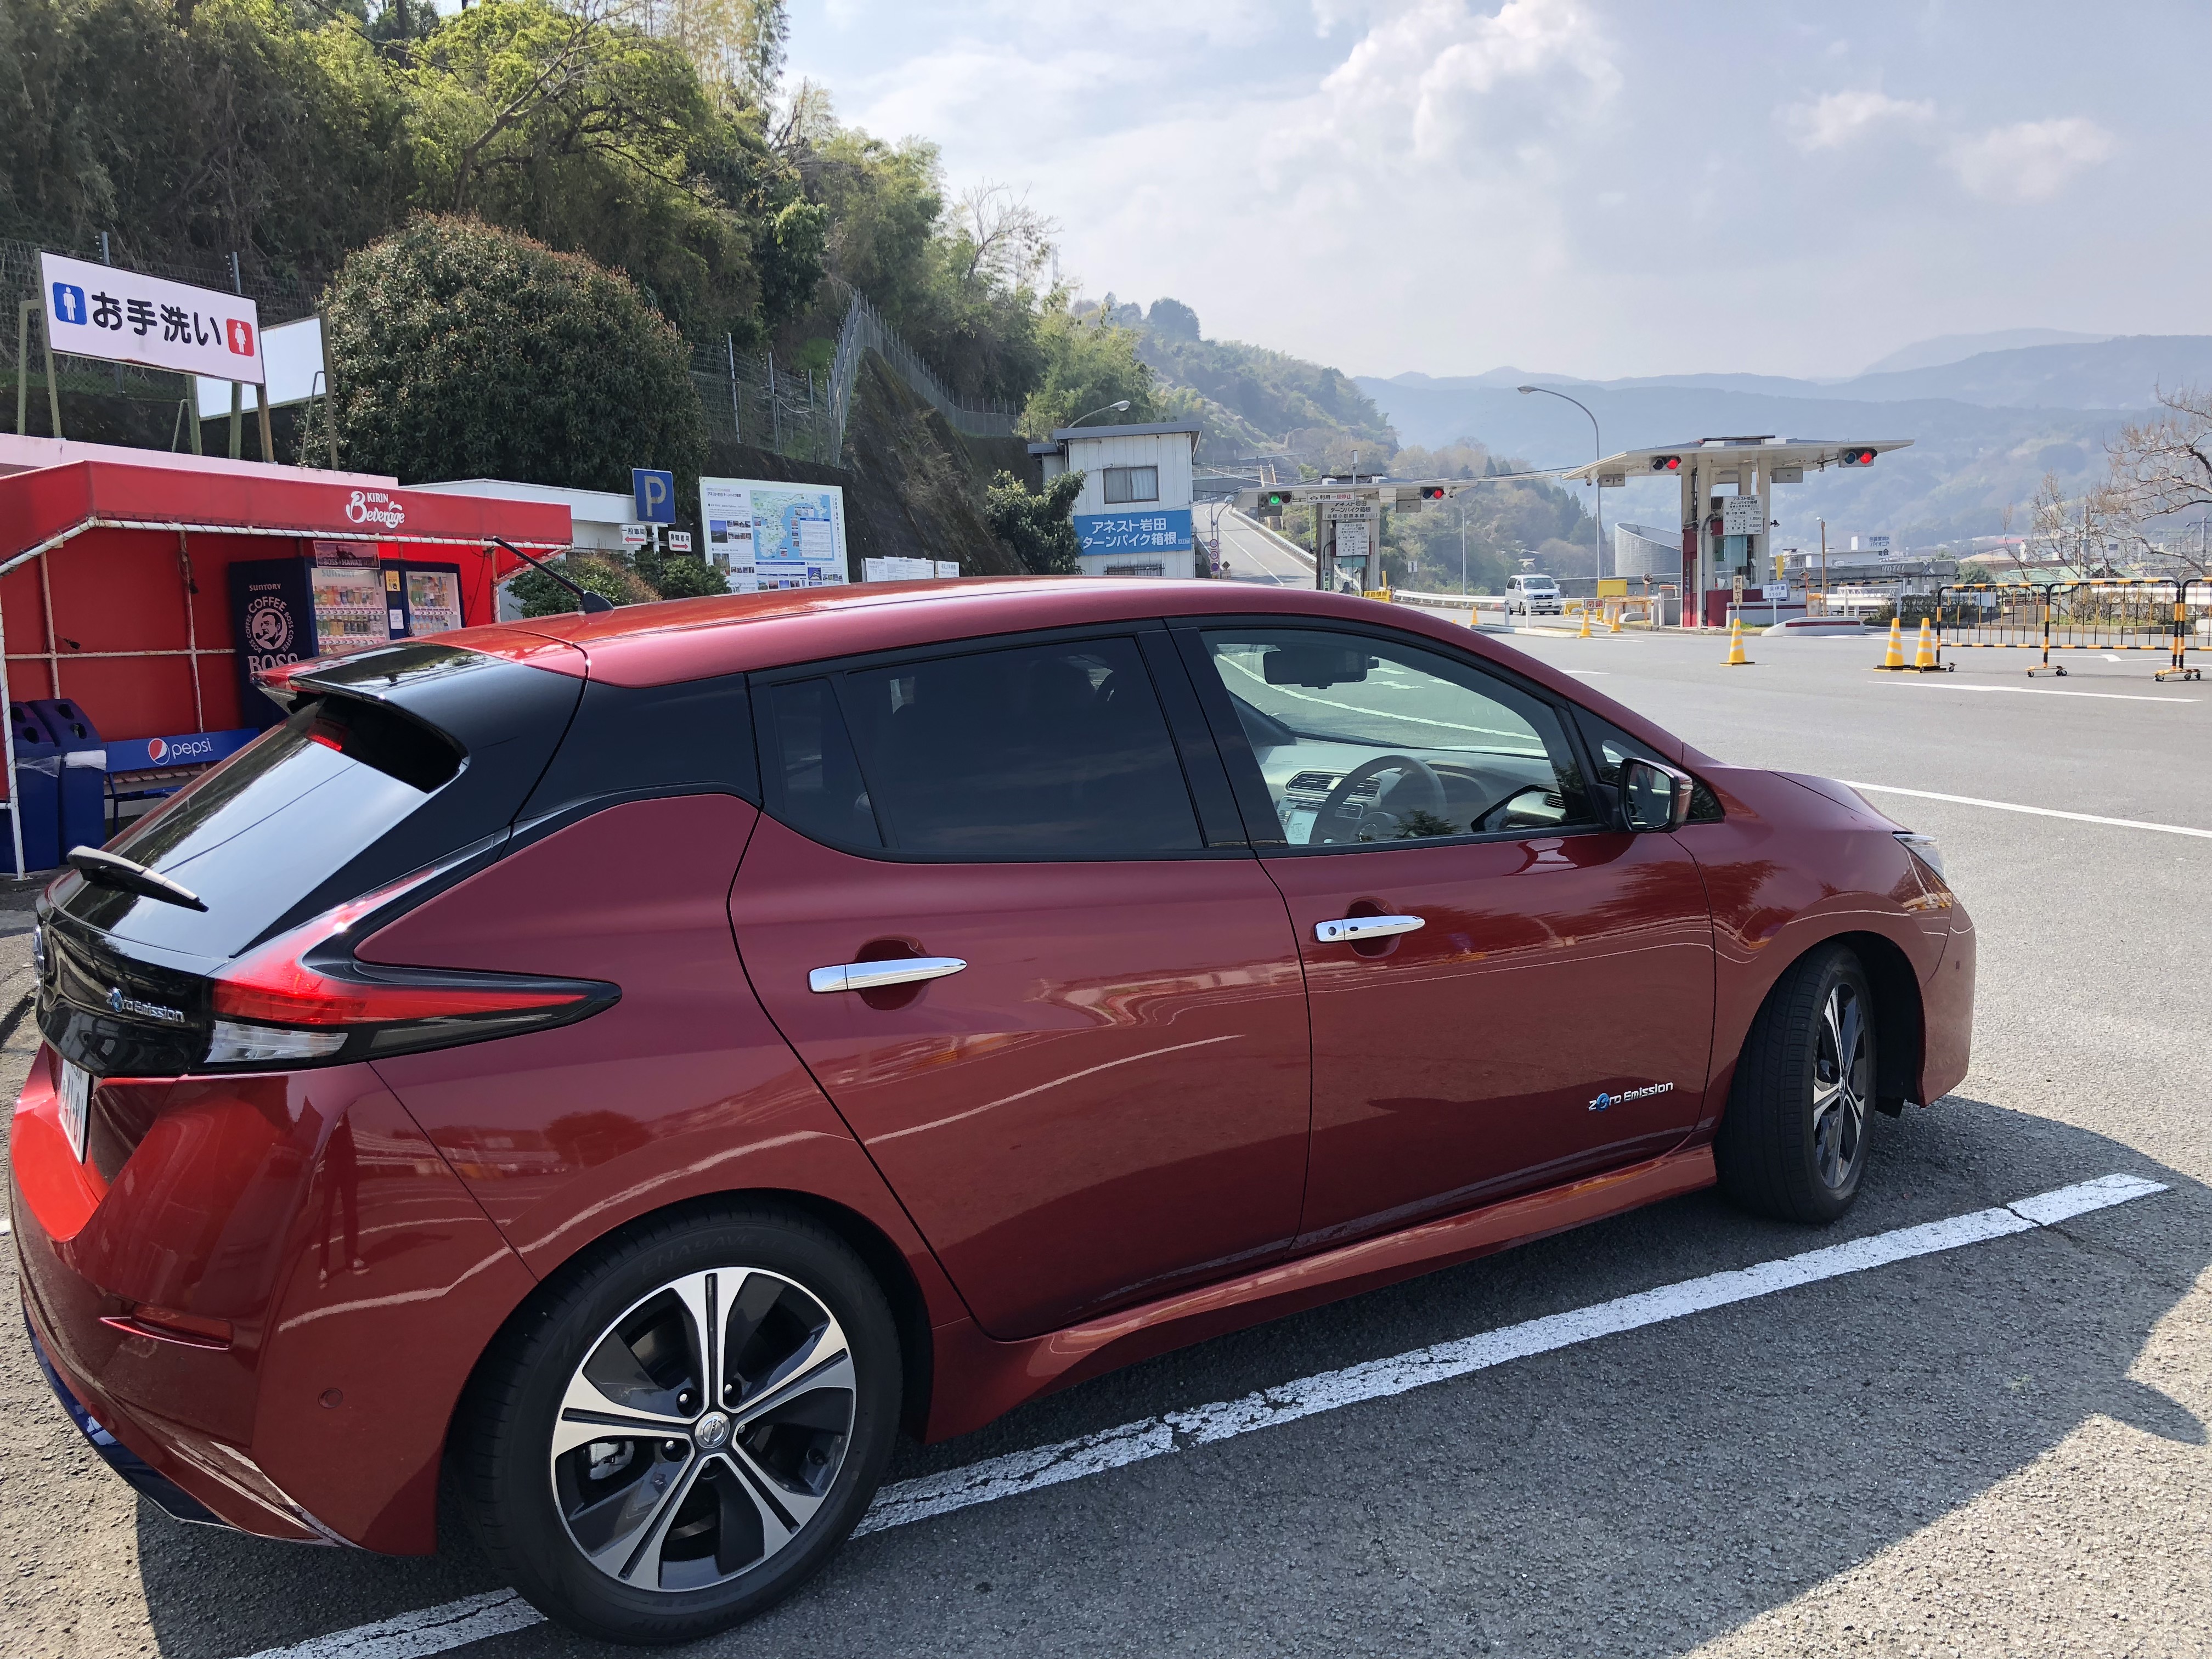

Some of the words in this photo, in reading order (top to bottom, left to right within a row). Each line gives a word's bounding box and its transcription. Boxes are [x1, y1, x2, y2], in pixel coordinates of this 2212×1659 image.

[91, 291, 222, 346] お手洗い
[366, 492, 389, 503] KIRIN
[644, 476, 666, 517] P
[346, 490, 405, 529] Beverage
[1091, 518, 1166, 534] アネスト岩田
[1082, 531, 1177, 549] ターンパイク箱根
[249, 583, 281, 591] SUNTORY
[248, 596, 287, 613] COFFEE
[284, 612, 294, 629] BOSS
[249, 639, 262, 653] BOSS
[281, 630, 294, 652] COFFEE
[172, 737, 212, 759] pepsi
[133, 1001, 185, 1023] Emission
[1623, 1081, 1674, 1102] Emission
